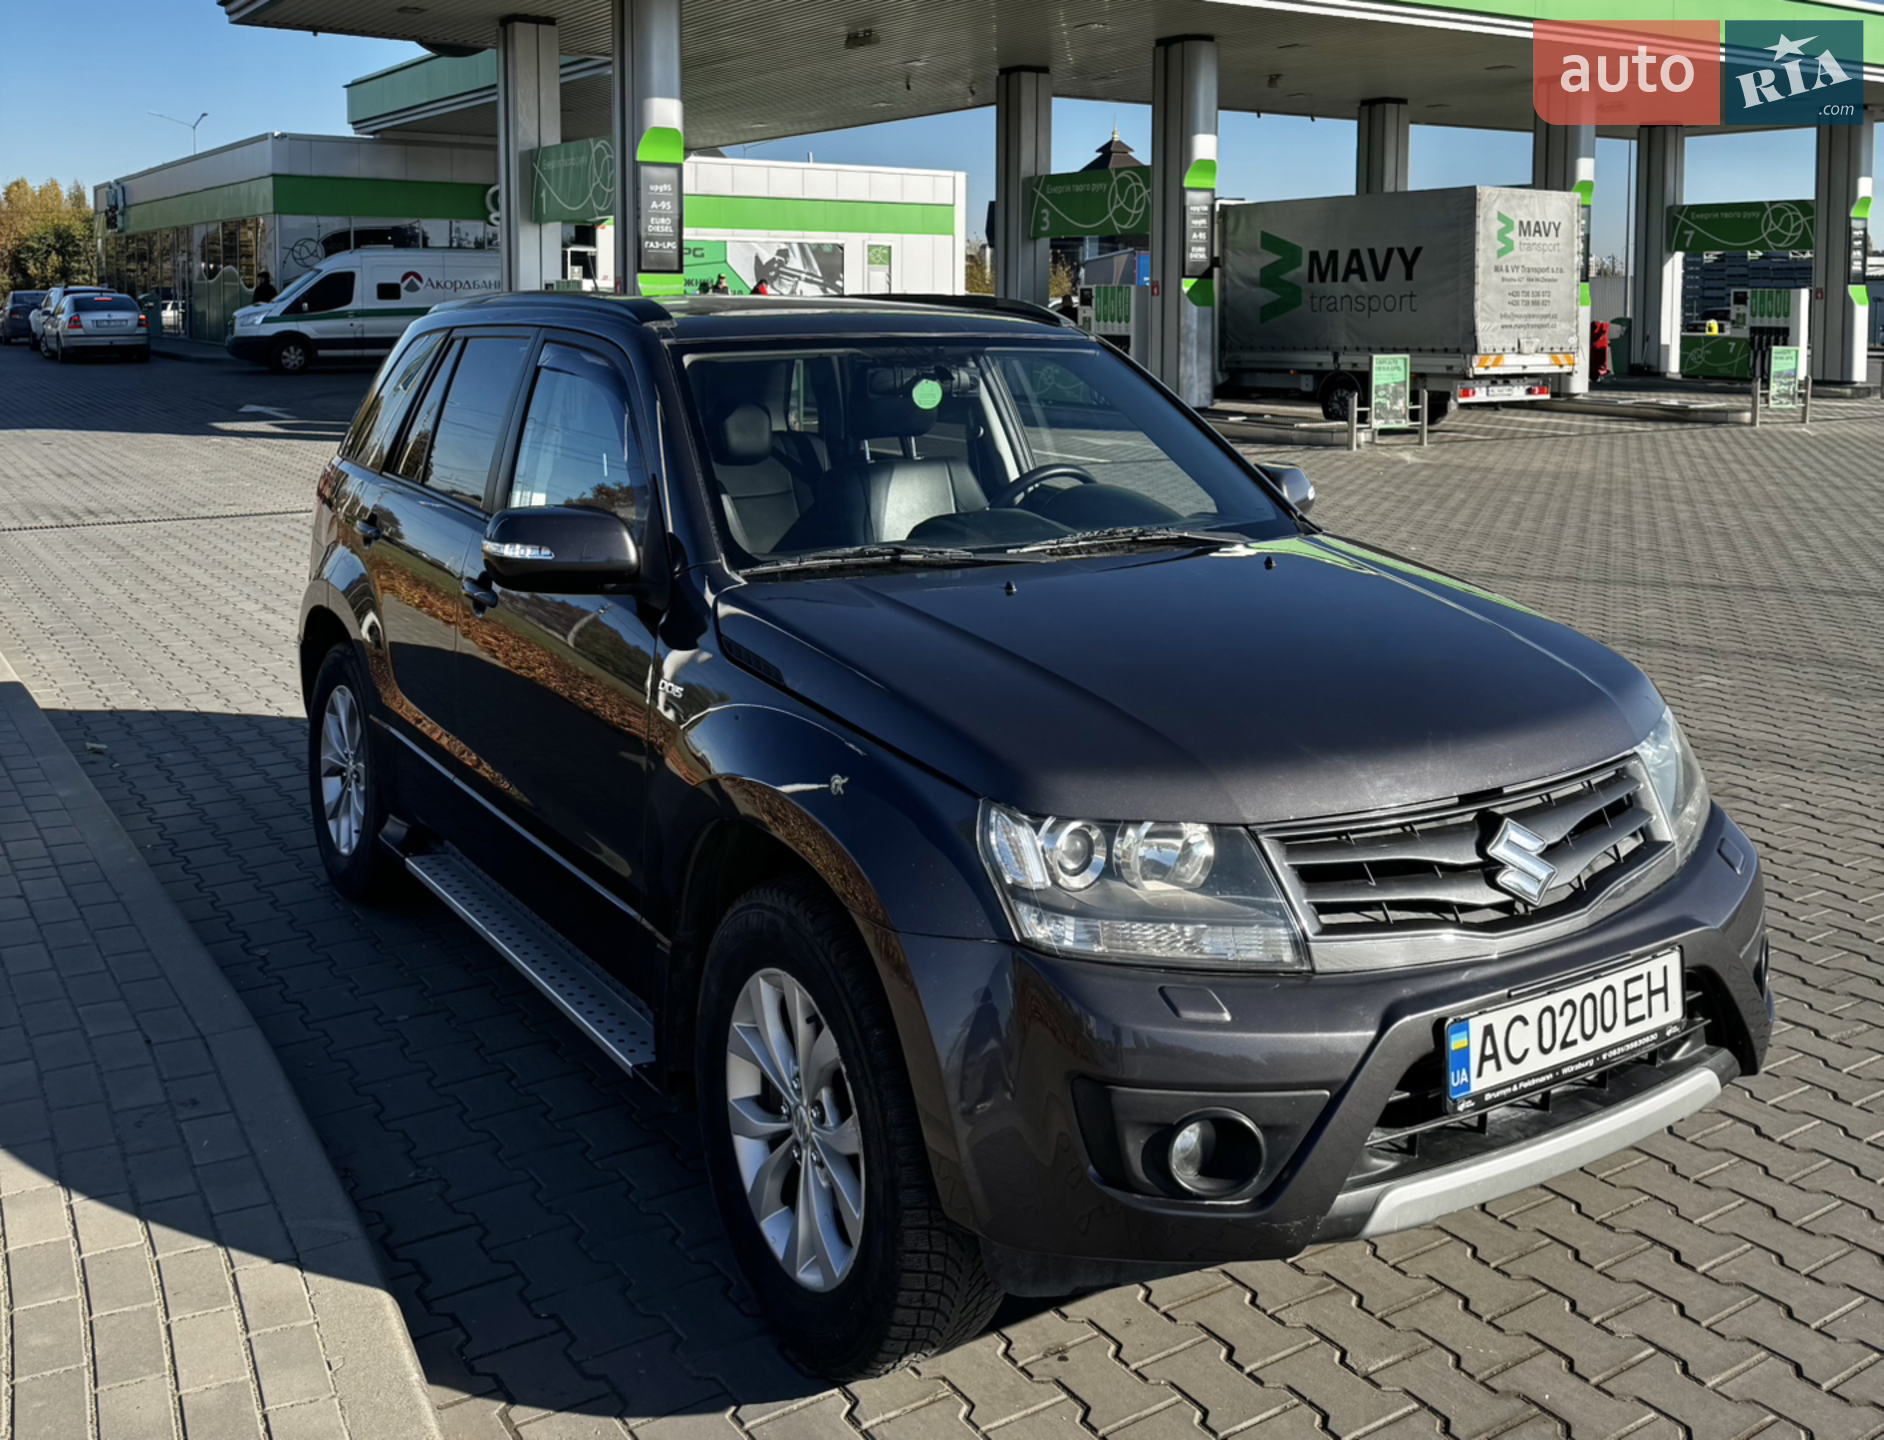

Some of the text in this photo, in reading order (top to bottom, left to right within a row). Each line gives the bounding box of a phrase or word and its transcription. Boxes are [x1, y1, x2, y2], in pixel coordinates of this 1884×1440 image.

[650, 200, 672, 210] A-95
[647, 225, 674, 233] DIESEL
[650, 216, 672, 225] EURO
[1040, 208, 1050, 232] 3
[1518, 220, 1562, 238] MAVY
[1519, 241, 1560, 254] transport
[1683, 230, 1695, 248] 7
[1308, 246, 1423, 283] MAVY
[1309, 290, 1418, 319] transport
[1728, 342, 1736, 353] 7
[1476, 964, 1669, 1079] AC 0200 EH
[1451, 1067, 1469, 1087] UA
